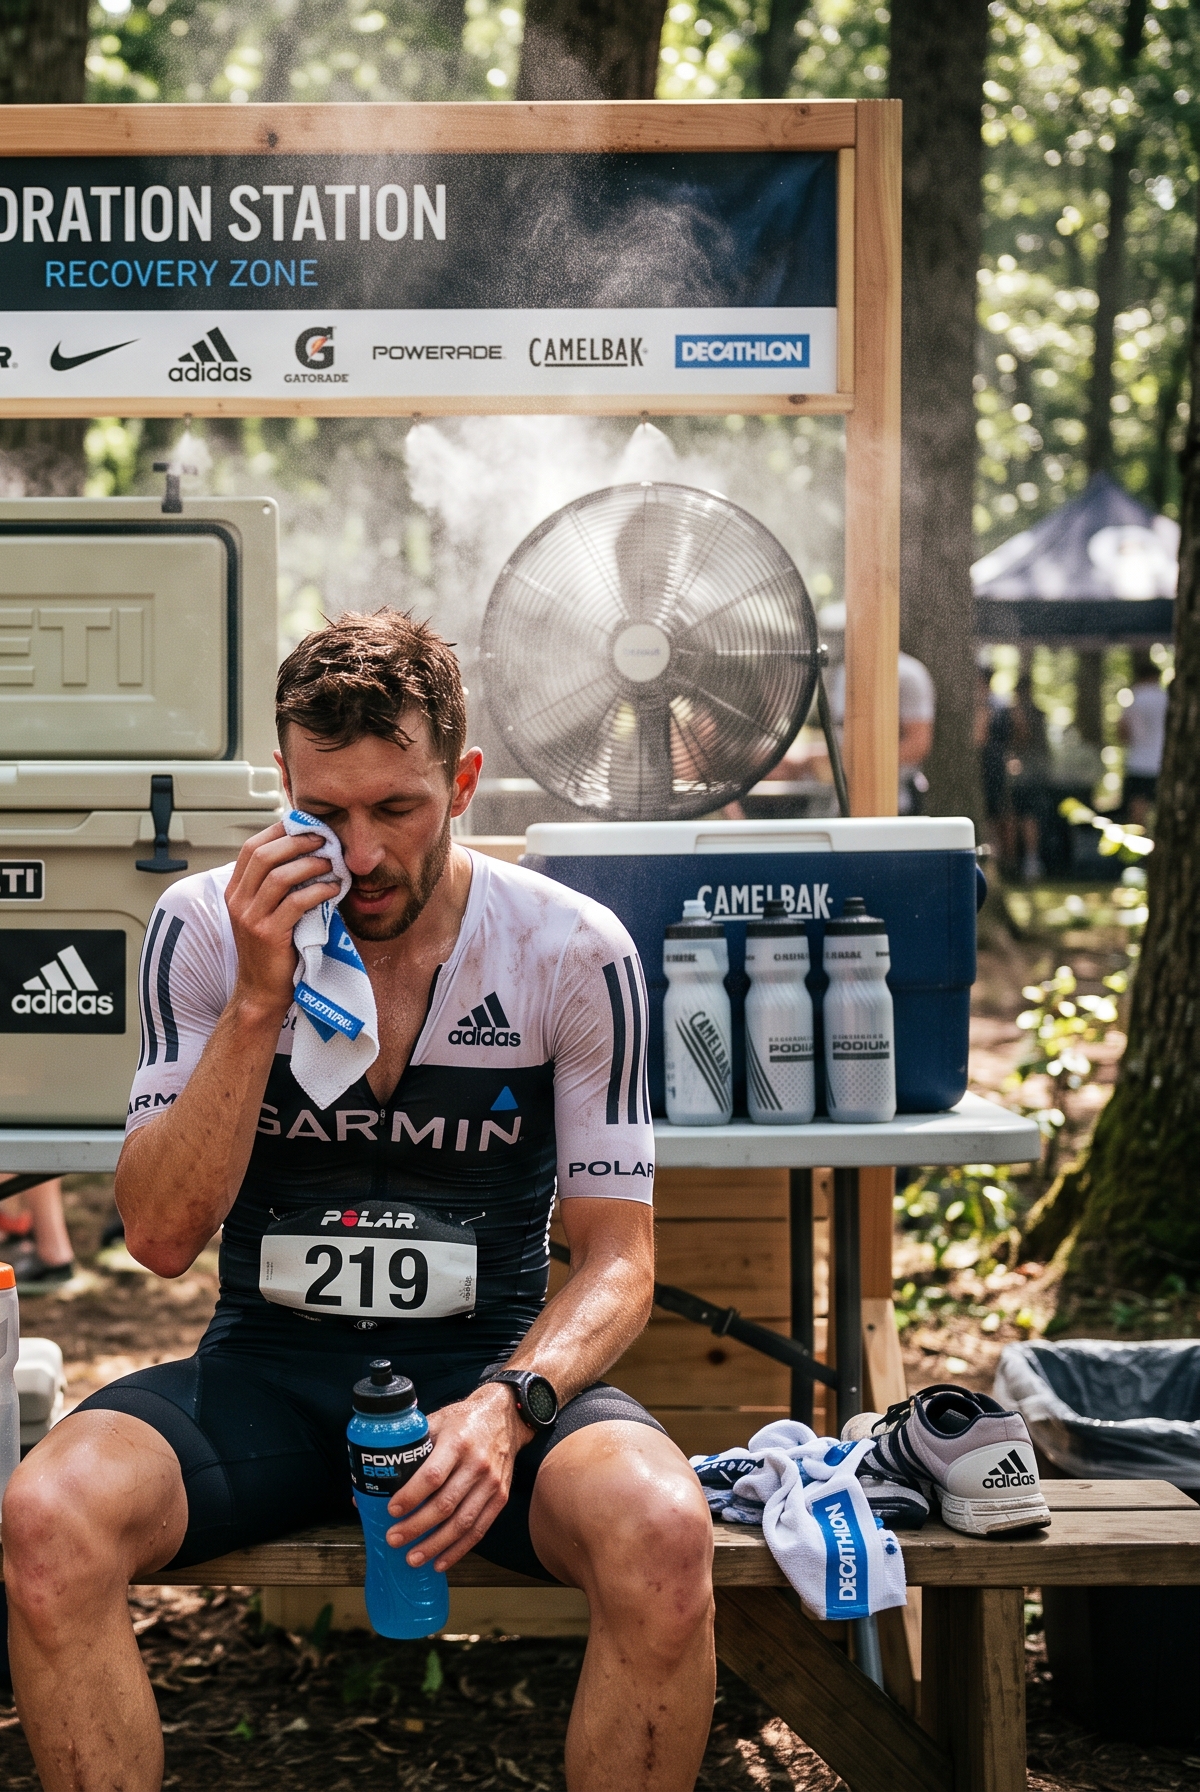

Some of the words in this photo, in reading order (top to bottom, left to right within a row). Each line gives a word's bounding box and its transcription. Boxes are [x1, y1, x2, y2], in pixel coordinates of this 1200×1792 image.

[227, 183, 447, 243] STATION
[45, 259, 218, 288] RECOVERY
[229, 259, 319, 288] ZONE
[372, 345, 502, 361] POWERADE
[529, 337, 643, 368] CAMELBAK
[681, 340, 803, 362] DECATHLON
[168, 361, 252, 383] adidas
[283, 373, 349, 384] GATORADE
[11, 989, 114, 1015] adidas
[447, 1027, 522, 1048] adidas
[832, 1041, 890, 1051] PODIUM
[568, 1160, 654, 1179] POLAR
[320, 1210, 416, 1229] POLAR
[304, 1244, 429, 1310] 219
[982, 1471, 1036, 1489] adidas
[825, 1502, 857, 1601] DECATHLON
